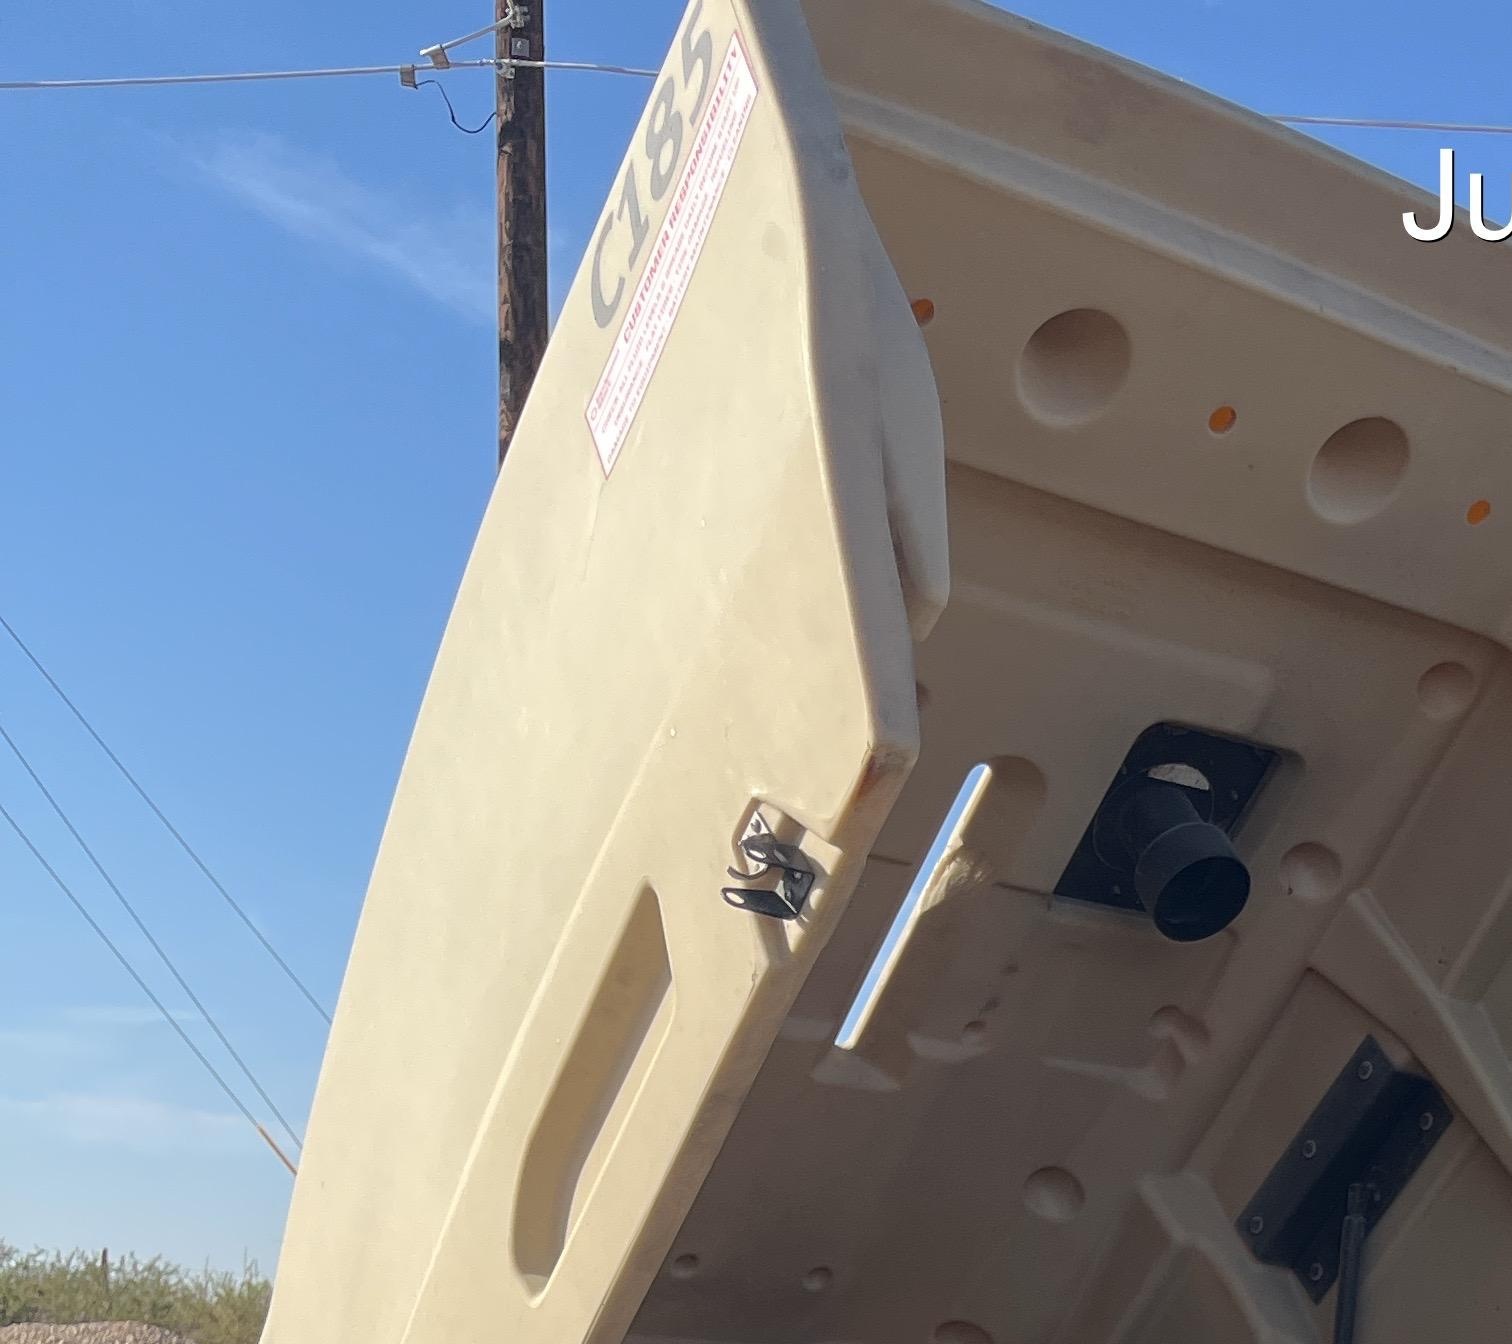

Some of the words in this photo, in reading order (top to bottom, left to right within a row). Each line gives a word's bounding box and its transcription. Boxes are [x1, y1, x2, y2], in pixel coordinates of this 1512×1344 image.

[590, 0, 713, 329] C185
[623, 227, 670, 346] CUSTOMER
[668, 46, 738, 229] RESPONSIBILITY
